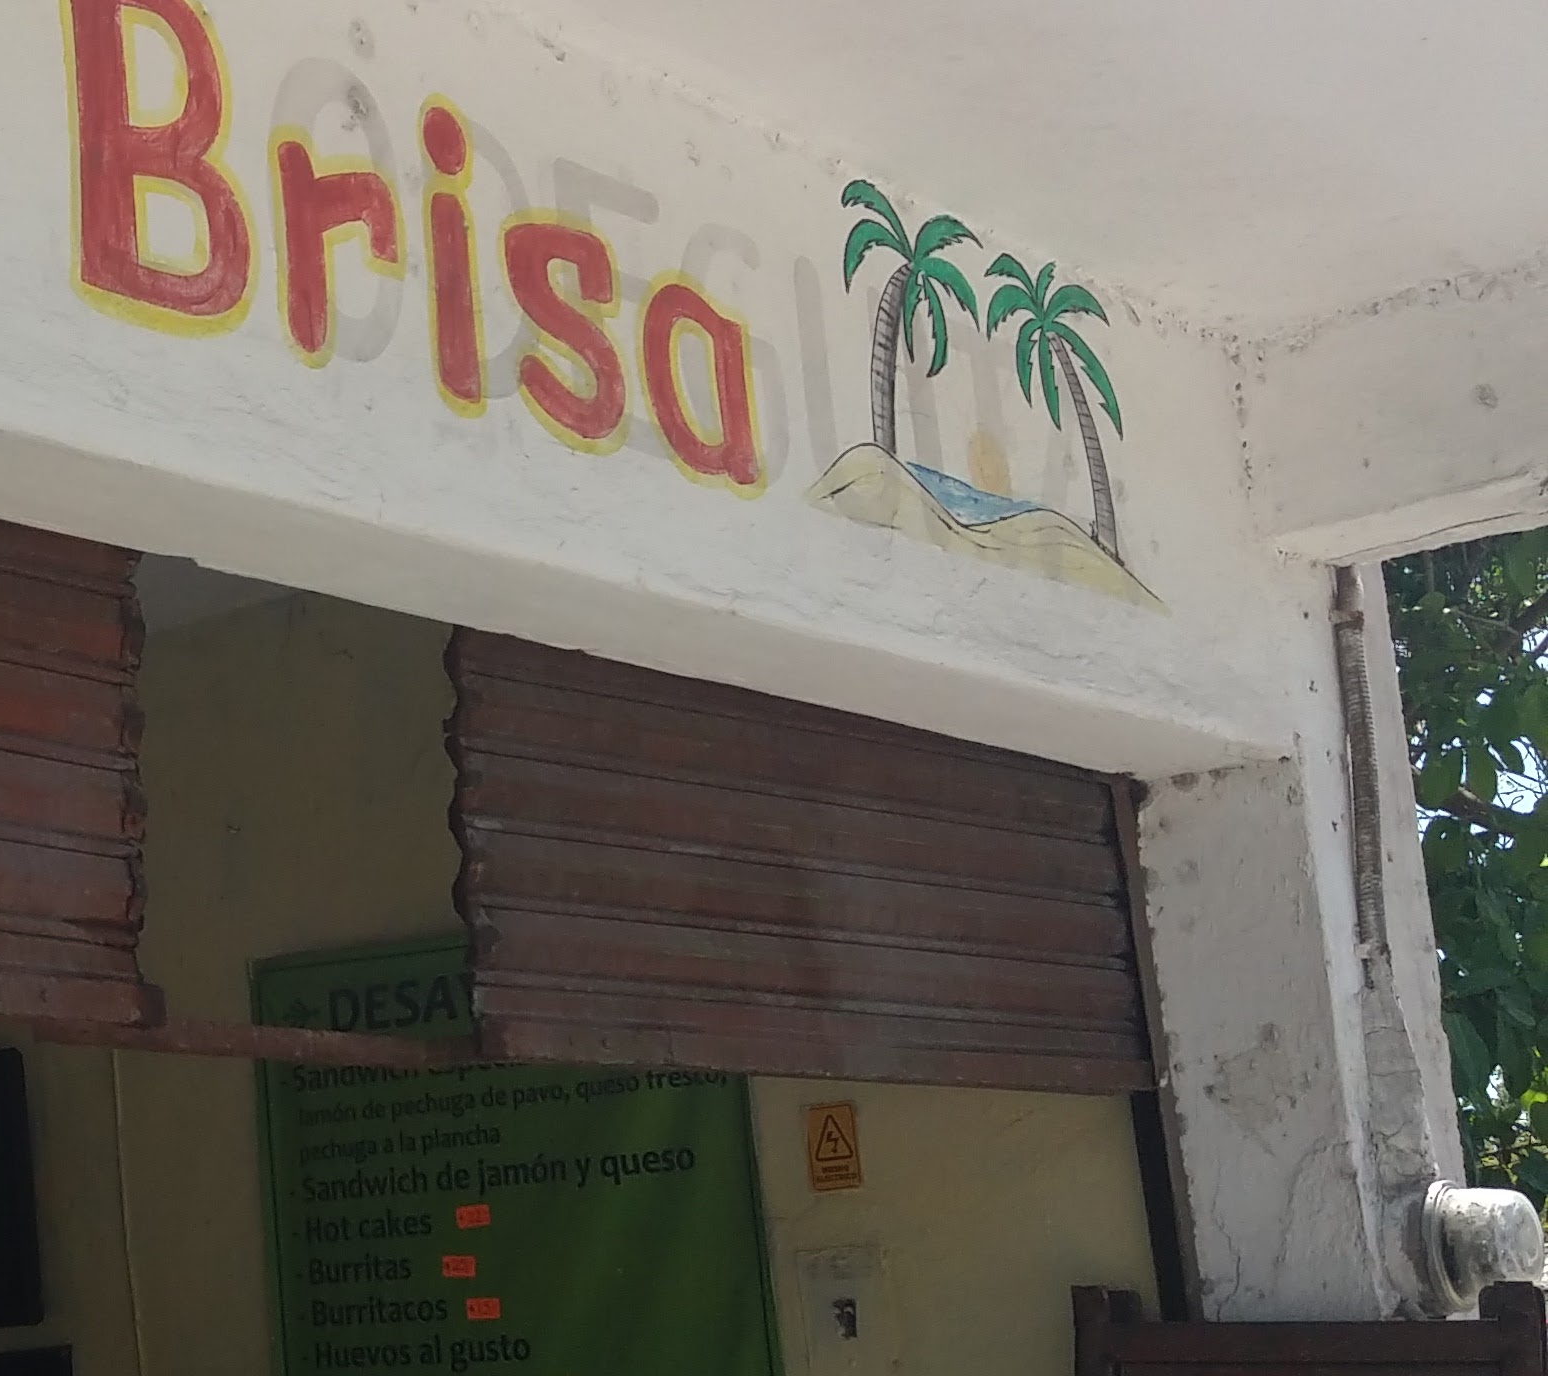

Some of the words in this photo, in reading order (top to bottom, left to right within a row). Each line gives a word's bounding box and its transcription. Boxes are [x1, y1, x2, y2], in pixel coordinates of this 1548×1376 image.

[363, 1096, 386, 1120] de
[392, 1092, 476, 1123] pechuga
[482, 1085, 507, 1107] de
[513, 1083, 570, 1110] pavo,
[576, 1075, 640, 1103] queso
[300, 1138, 377, 1168] pechuga
[382, 1136, 393, 1153] a
[399, 1130, 416, 1153] la
[421, 1123, 501, 1156] plancha
[302, 1164, 429, 1201] Sandwich
[436, 1161, 471, 1191] de
[477, 1153, 567, 1196] jamón
[575, 1156, 591, 1188] y
[601, 1147, 695, 1186] queso
[307, 1215, 350, 1244] Hot
[359, 1208, 432, 1238] cakes
[309, 1252, 412, 1285] Burritas
[312, 1296, 448, 1326] Burritacos
[314, 1341, 412, 1368] Huevos
[419, 1335, 442, 1364] al
[450, 1335, 531, 1372] gusto
